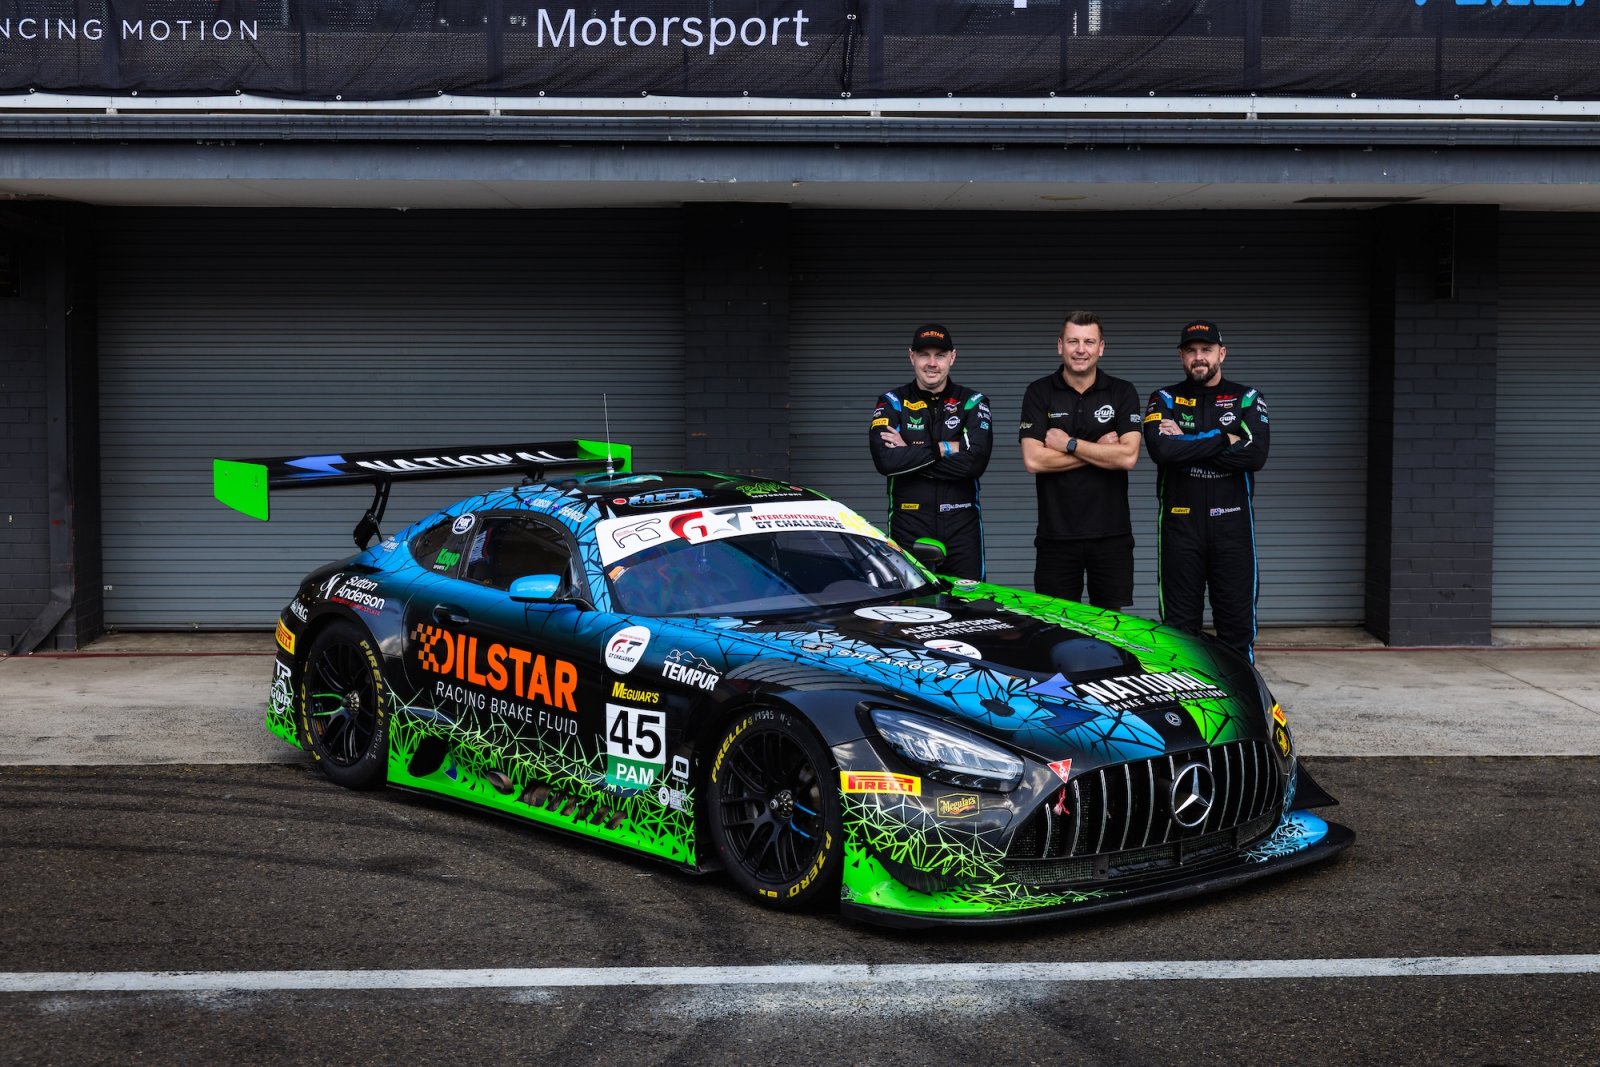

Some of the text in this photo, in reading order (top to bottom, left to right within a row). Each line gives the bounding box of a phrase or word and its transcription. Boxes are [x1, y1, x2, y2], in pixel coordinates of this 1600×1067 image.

[122, 19, 258, 41] MOTION
[537, 8, 809, 55] Motorsport
[751, 514, 839, 522] INTERCONTINENTAL
[756, 519, 845, 530] GT CHALLENGE
[435, 548, 461, 571] Kayo
[346, 575, 378, 591] Sutton
[334, 584, 385, 610] Anderson
[900, 617, 1002, 635] ALEX BRYDEN
[914, 622, 1015, 640] ARCHITECTURE
[420, 627, 578, 713] OILSTAR
[662, 660, 720, 691] TEMPUR
[836, 649, 967, 681] SHEARGOLD
[359, 640, 384, 718] PIRELLI
[1076, 671, 1217, 703] NATIONAL
[271, 686, 291, 708] GWR
[436, 681, 578, 736] RACING BRAKE FLUID
[1109, 689, 1228, 711] MAKE GOOD SOLUTIONS
[609, 709, 662, 759] 45
[711, 719, 747, 784] PIRELLI
[615, 762, 654, 786] PAM
[848, 774, 914, 792] PIRELLI
[789, 830, 832, 898] P ZERO
